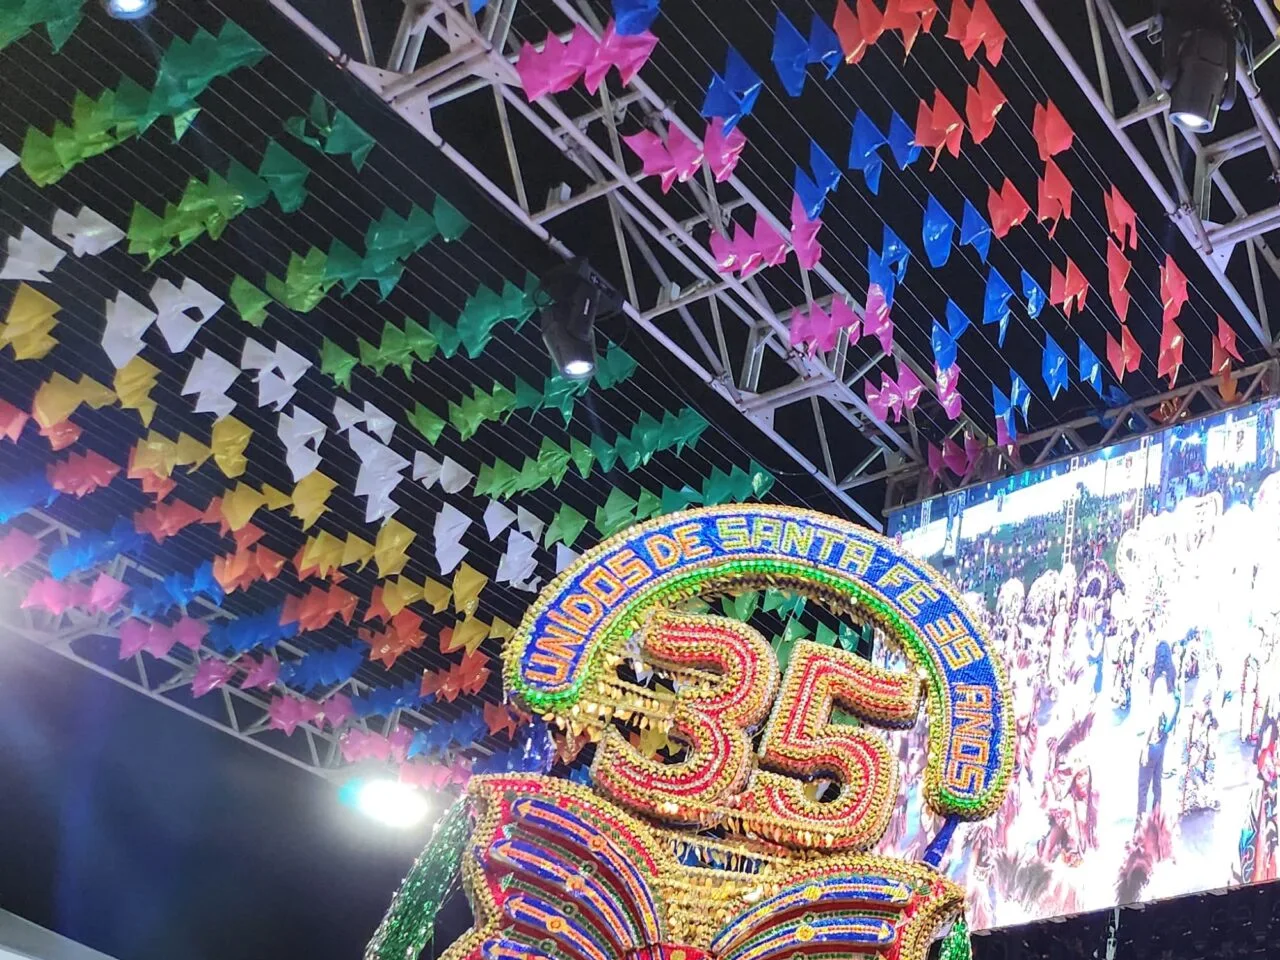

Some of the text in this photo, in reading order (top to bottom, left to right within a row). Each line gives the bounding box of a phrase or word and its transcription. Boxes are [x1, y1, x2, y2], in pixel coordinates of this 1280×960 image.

[644, 523, 712, 570] DE
[715, 517, 875, 577] SANTA
[525, 549, 653, 685] UNIDOS
[924, 613, 985, 671] 35
[593, 610, 922, 856] 35
[948, 683, 993, 794] ANOS
